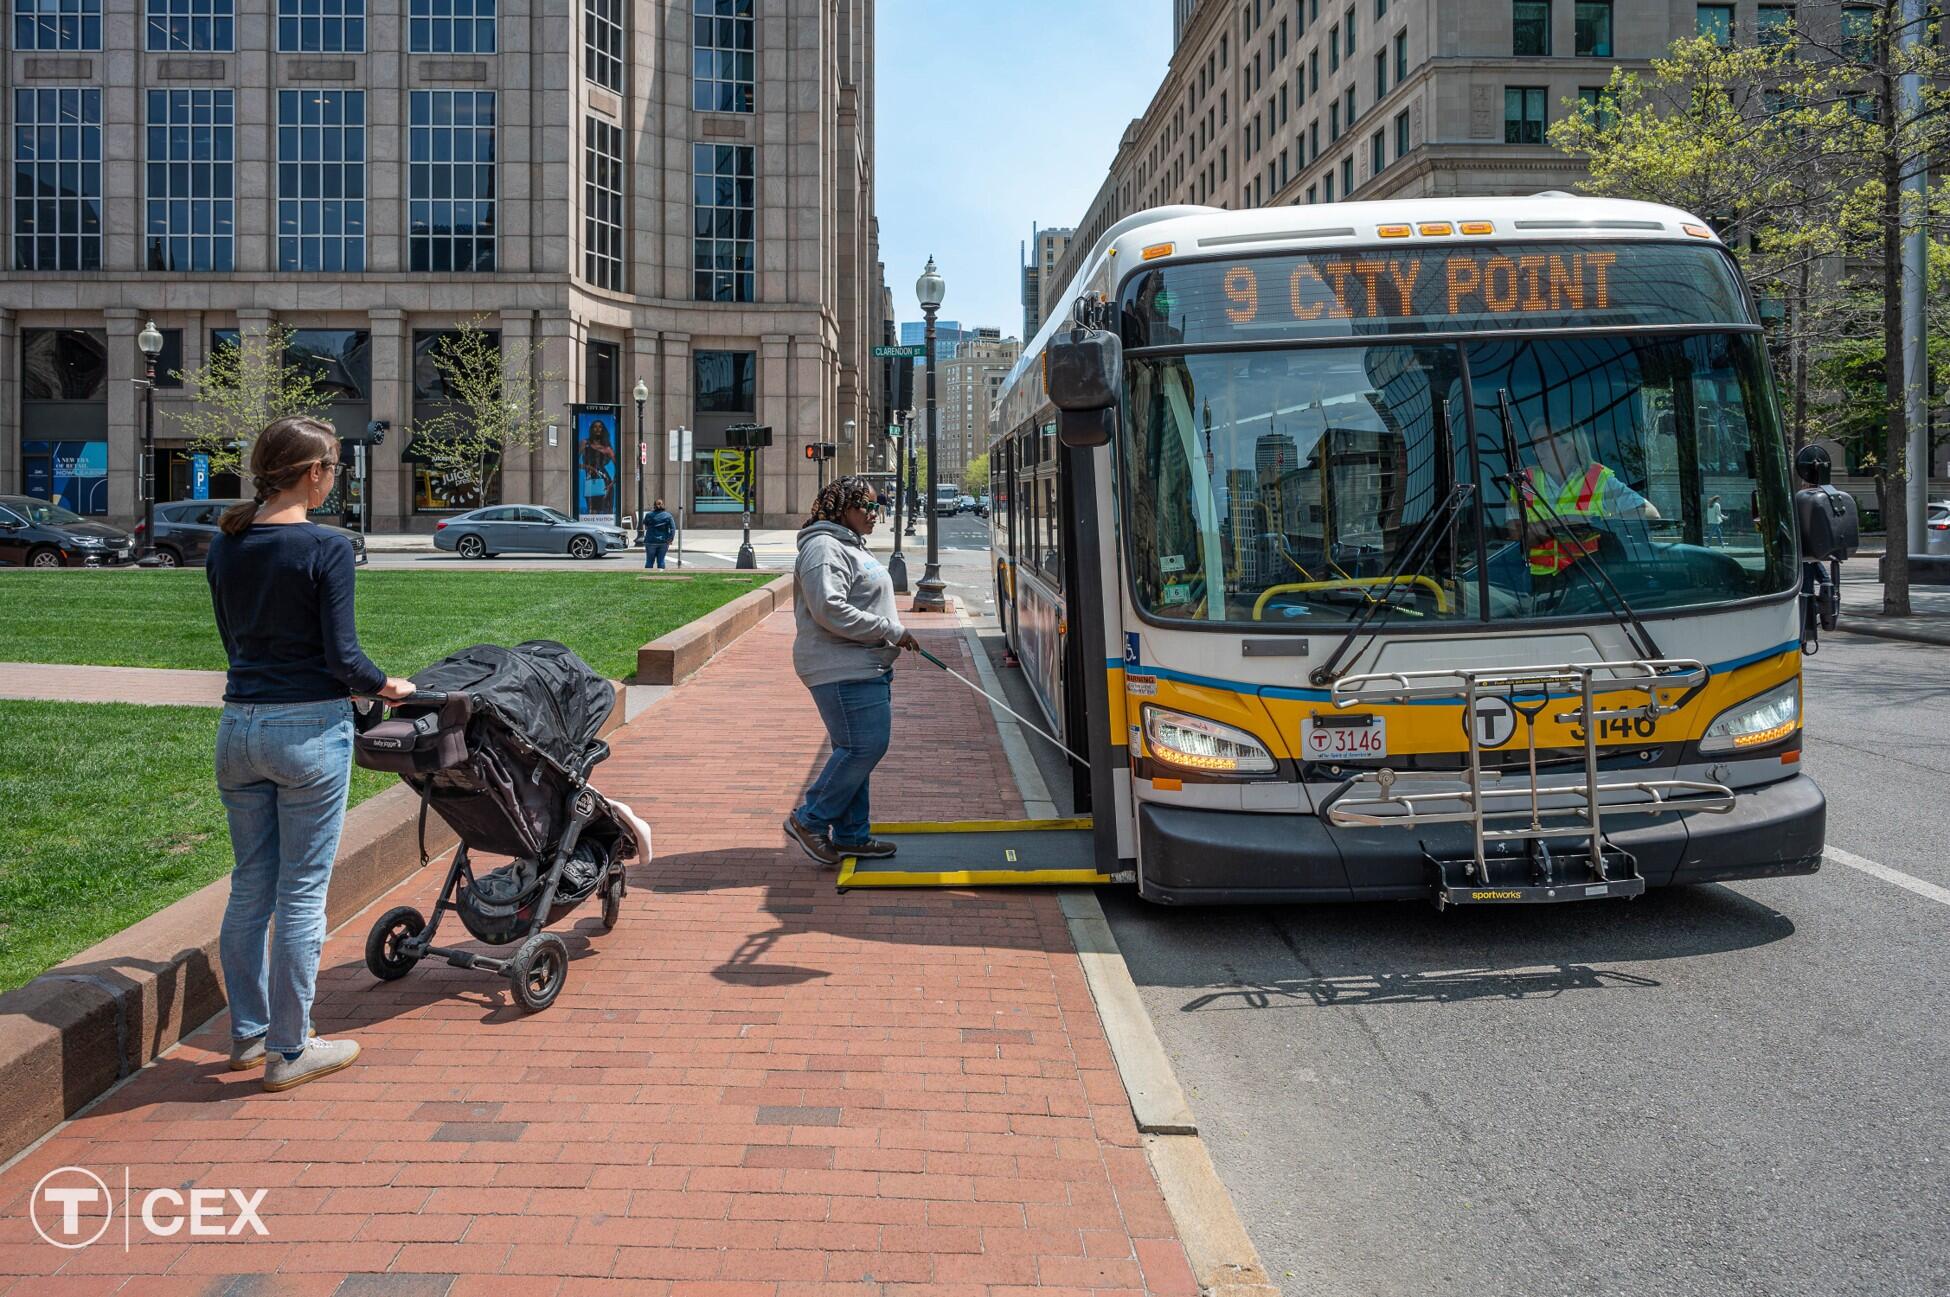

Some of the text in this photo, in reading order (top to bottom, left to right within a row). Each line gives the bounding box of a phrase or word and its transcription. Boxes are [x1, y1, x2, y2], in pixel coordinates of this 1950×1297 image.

[1223, 252, 1617, 323] 9 CITY POINT
[875, 347, 913, 356] CLARENDON
[197, 472, 205, 487] P
[442, 468, 472, 486] juice
[373, 739, 383, 747] baby
[1335, 729, 1382, 752] 3146
[1471, 890, 1521, 901] sportworks
